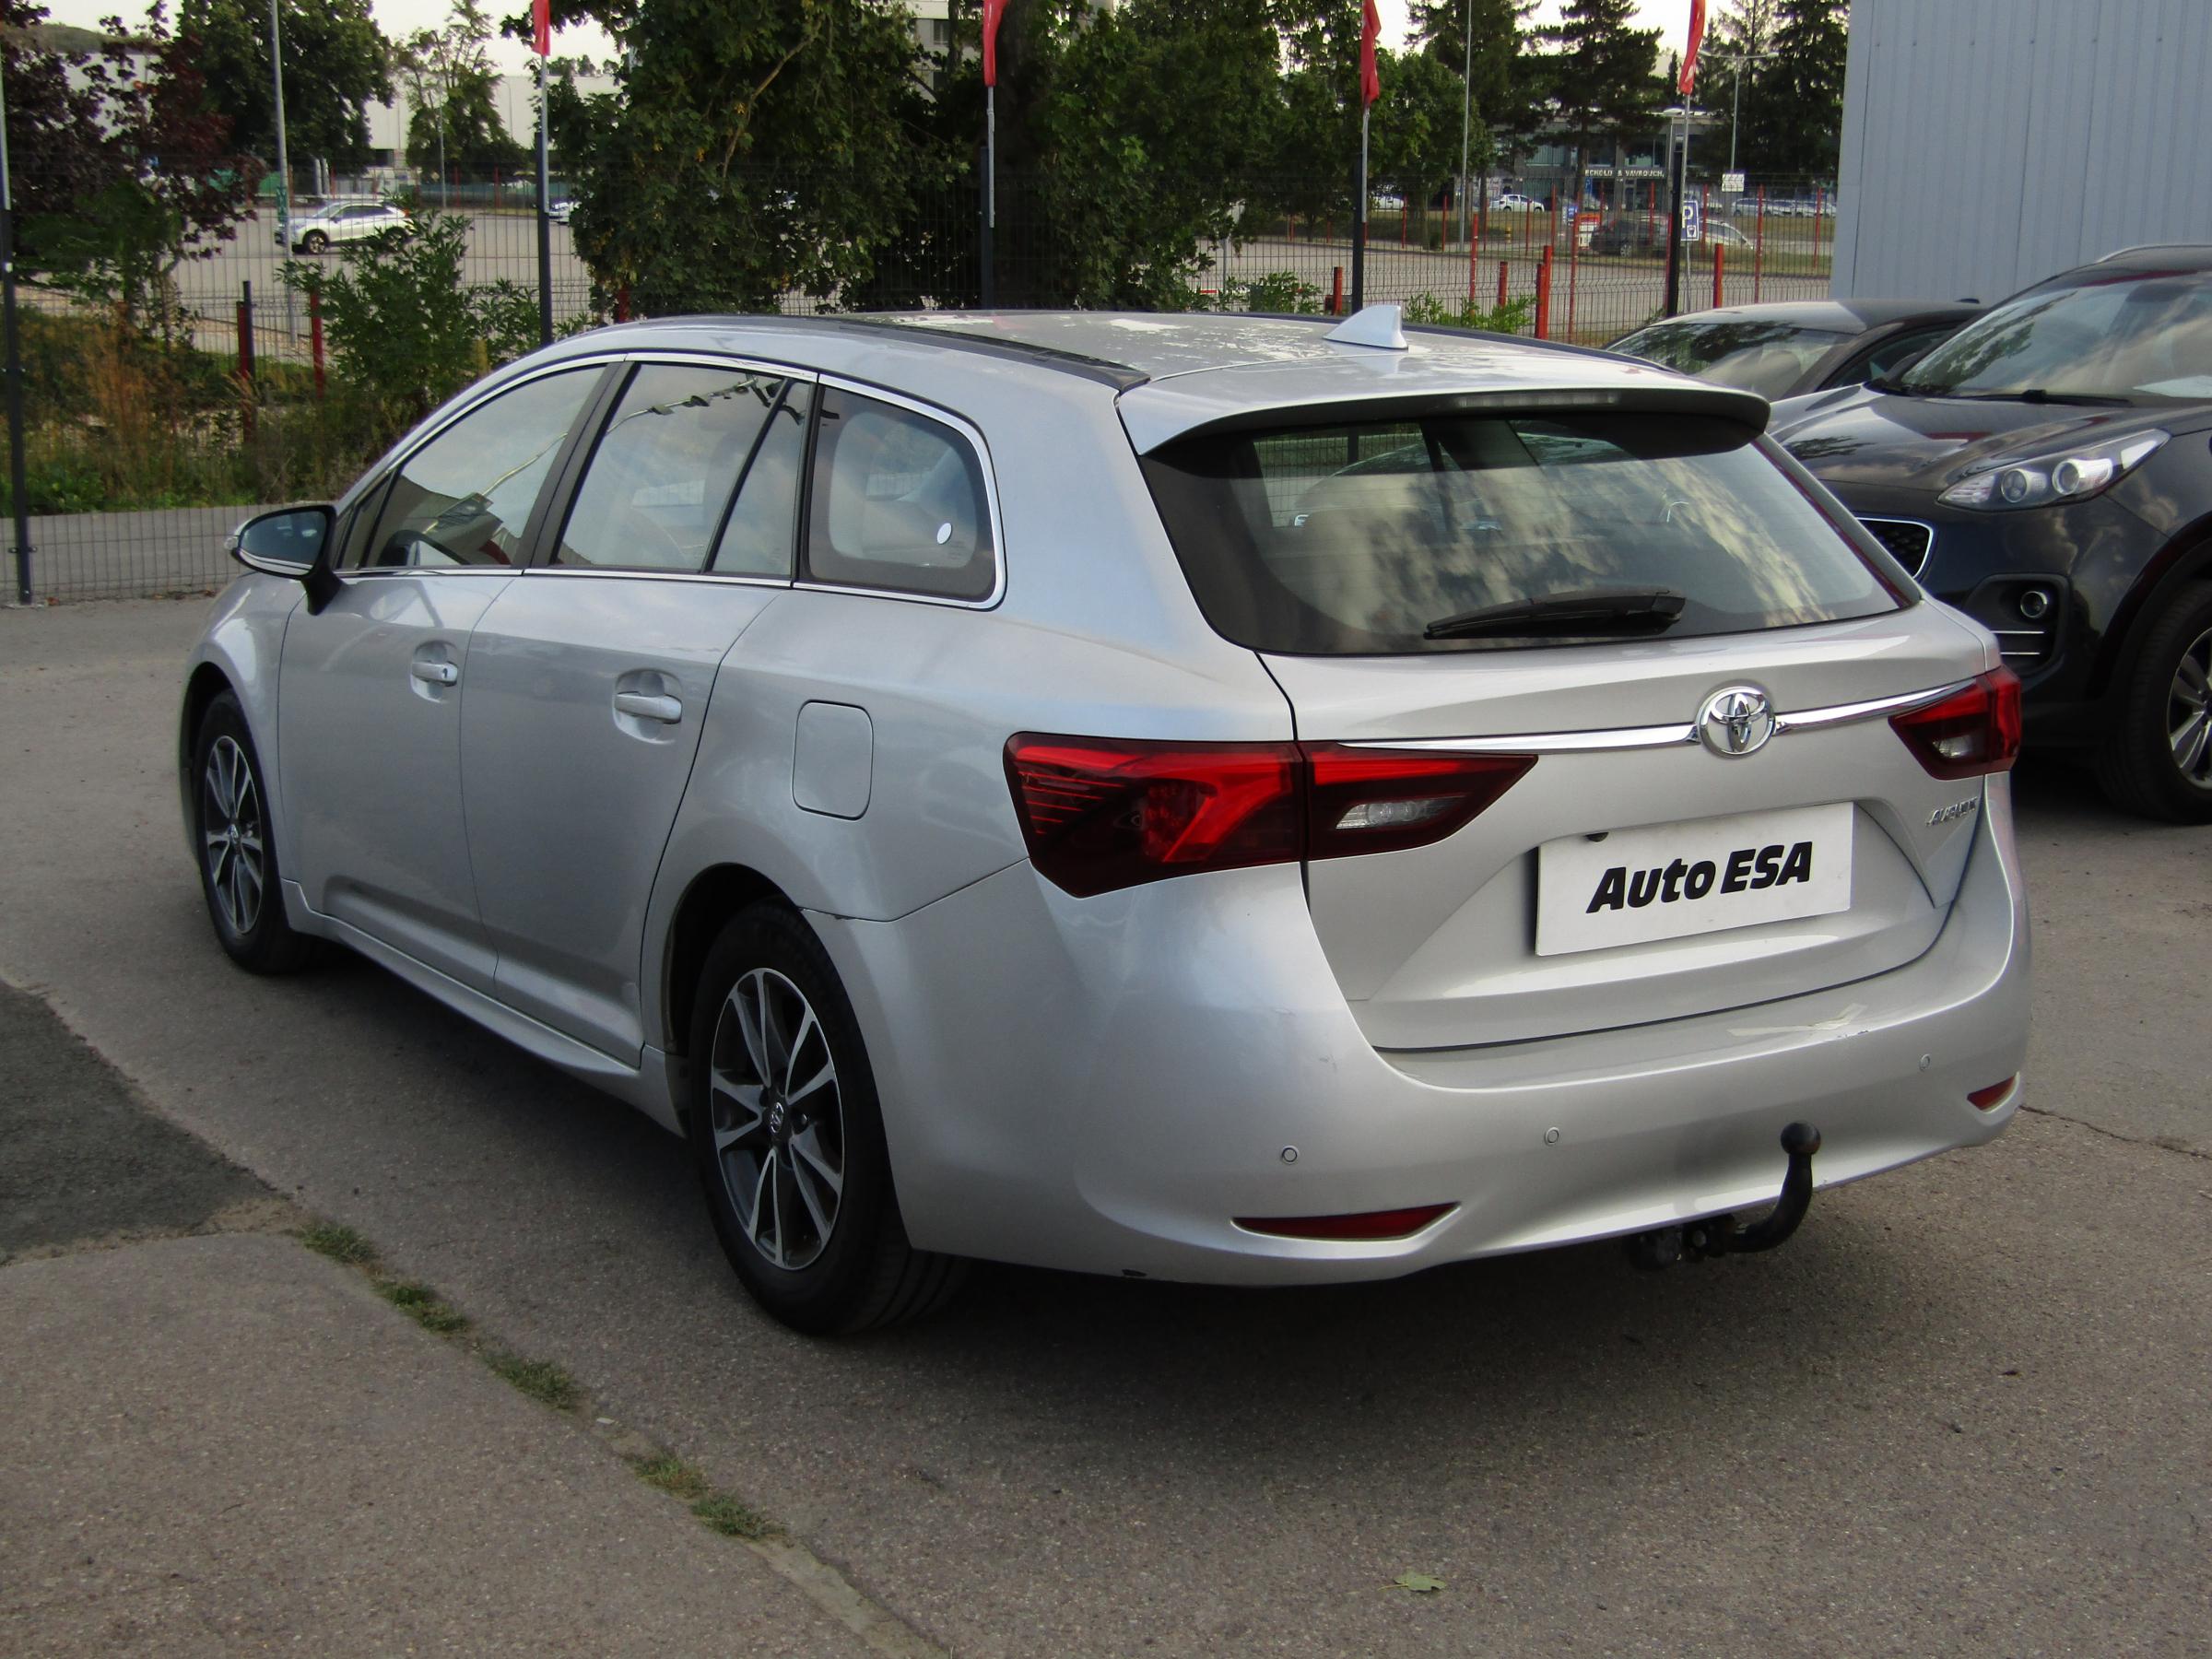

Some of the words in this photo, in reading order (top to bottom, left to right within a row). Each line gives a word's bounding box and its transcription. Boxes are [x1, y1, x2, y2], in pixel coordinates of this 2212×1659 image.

[1682, 206, 1694, 229] P
[1585, 858, 1716, 913] Auto
[1720, 841, 1813, 894] ESA
